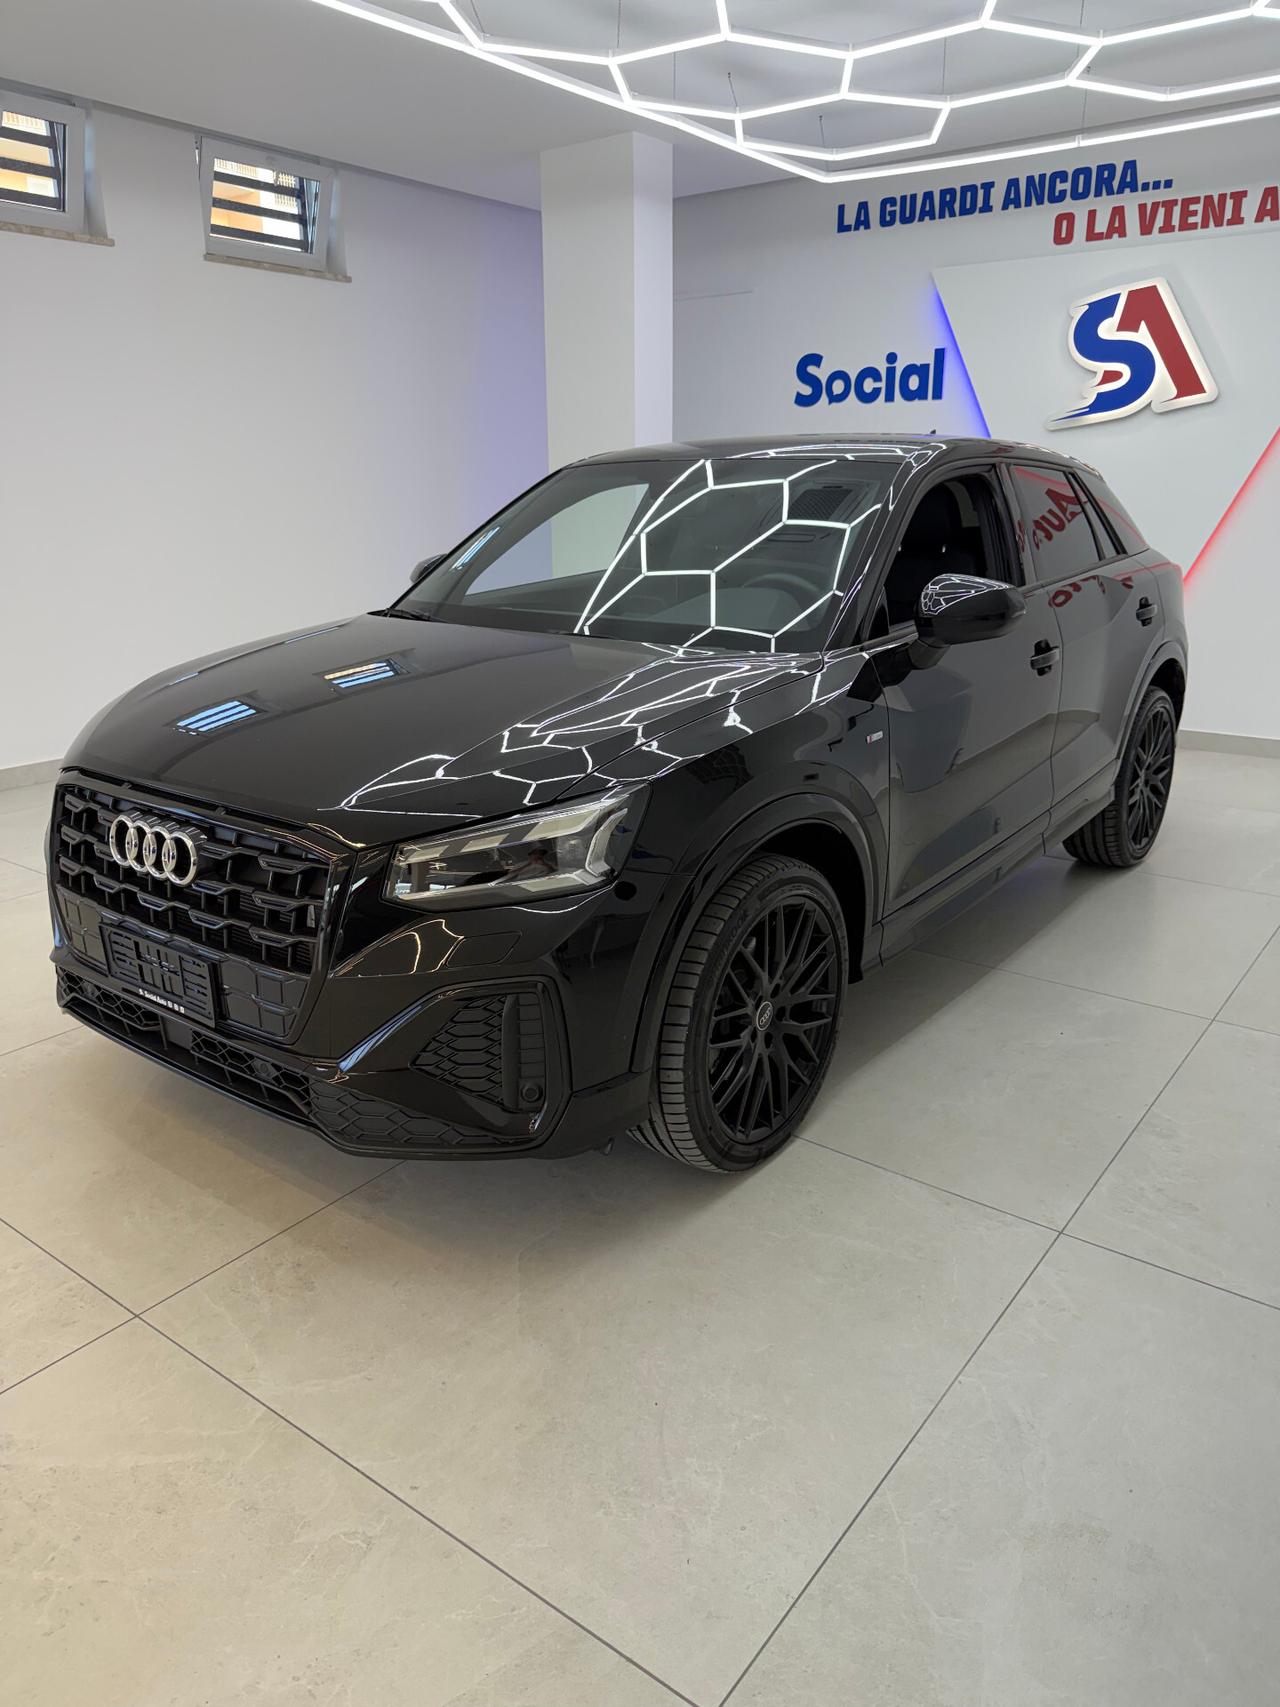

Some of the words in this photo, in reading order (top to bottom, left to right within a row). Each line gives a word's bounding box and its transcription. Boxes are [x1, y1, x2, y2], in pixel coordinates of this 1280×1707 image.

[836, 201, 871, 234] LA
[879, 181, 995, 228] GUARDI
[1001, 159, 1173, 211] ANCORA...
[1053, 211, 1075, 246] O
[1085, 205, 1127, 242] LA
[1138, 189, 1247, 237] VIENI
[794, 347, 946, 408] Social
